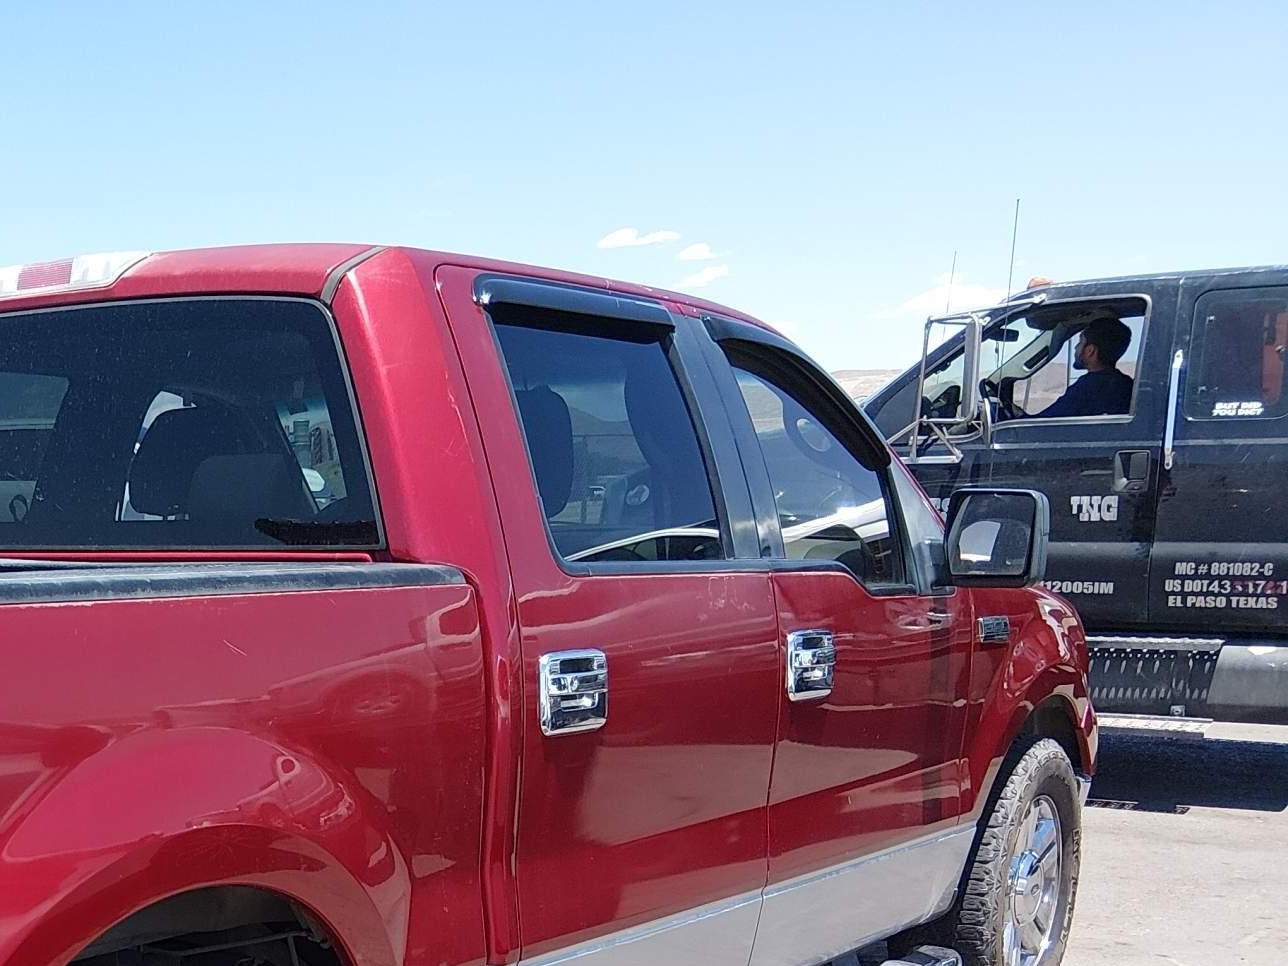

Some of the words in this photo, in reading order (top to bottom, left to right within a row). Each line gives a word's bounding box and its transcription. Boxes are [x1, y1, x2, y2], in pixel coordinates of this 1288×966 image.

[1174, 562, 1196, 575] MC
[1197, 563, 1209, 575] #
[1210, 562, 1274, 576] 881082-C
[1164, 579, 1182, 592] US
[1167, 595, 1184, 607] EL
[1186, 596, 1227, 608] PASO
[1230, 597, 1278, 609] TEXAS
